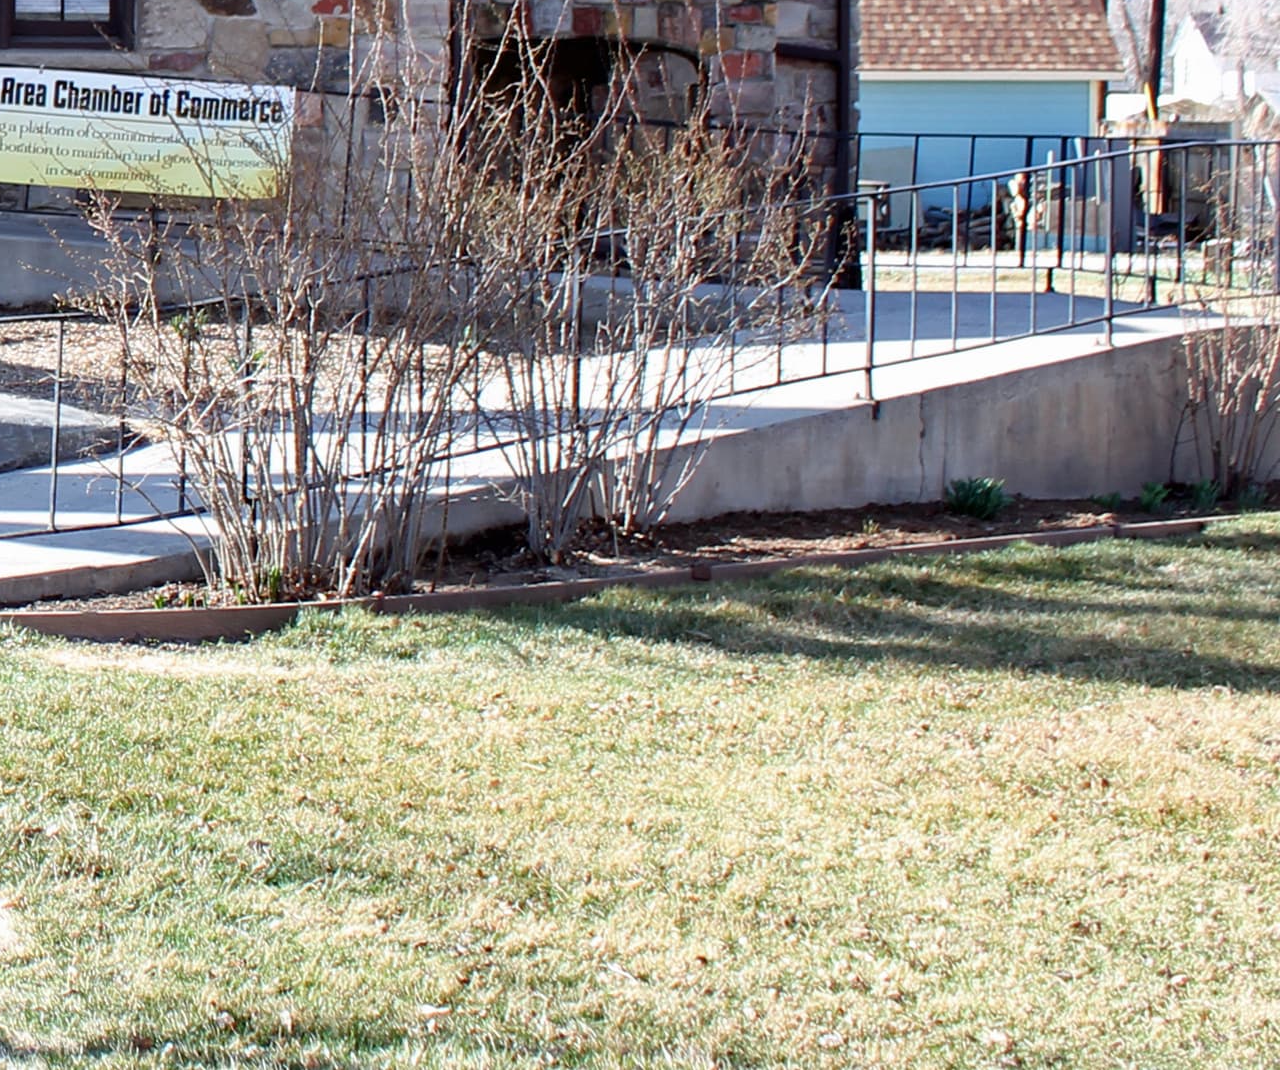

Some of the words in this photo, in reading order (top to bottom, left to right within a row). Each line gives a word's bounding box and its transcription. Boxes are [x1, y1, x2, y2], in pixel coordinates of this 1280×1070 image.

[0, 77, 47, 108] Area
[53, 79, 144, 115] Chamber
[149, 89, 171, 117] of
[175, 90, 284, 124] Commerce
[8, 123, 17, 132] a
[19, 118, 75, 139] platform
[76, 121, 91, 139] of
[55, 145, 69, 157] to
[133, 149, 161, 163] and
